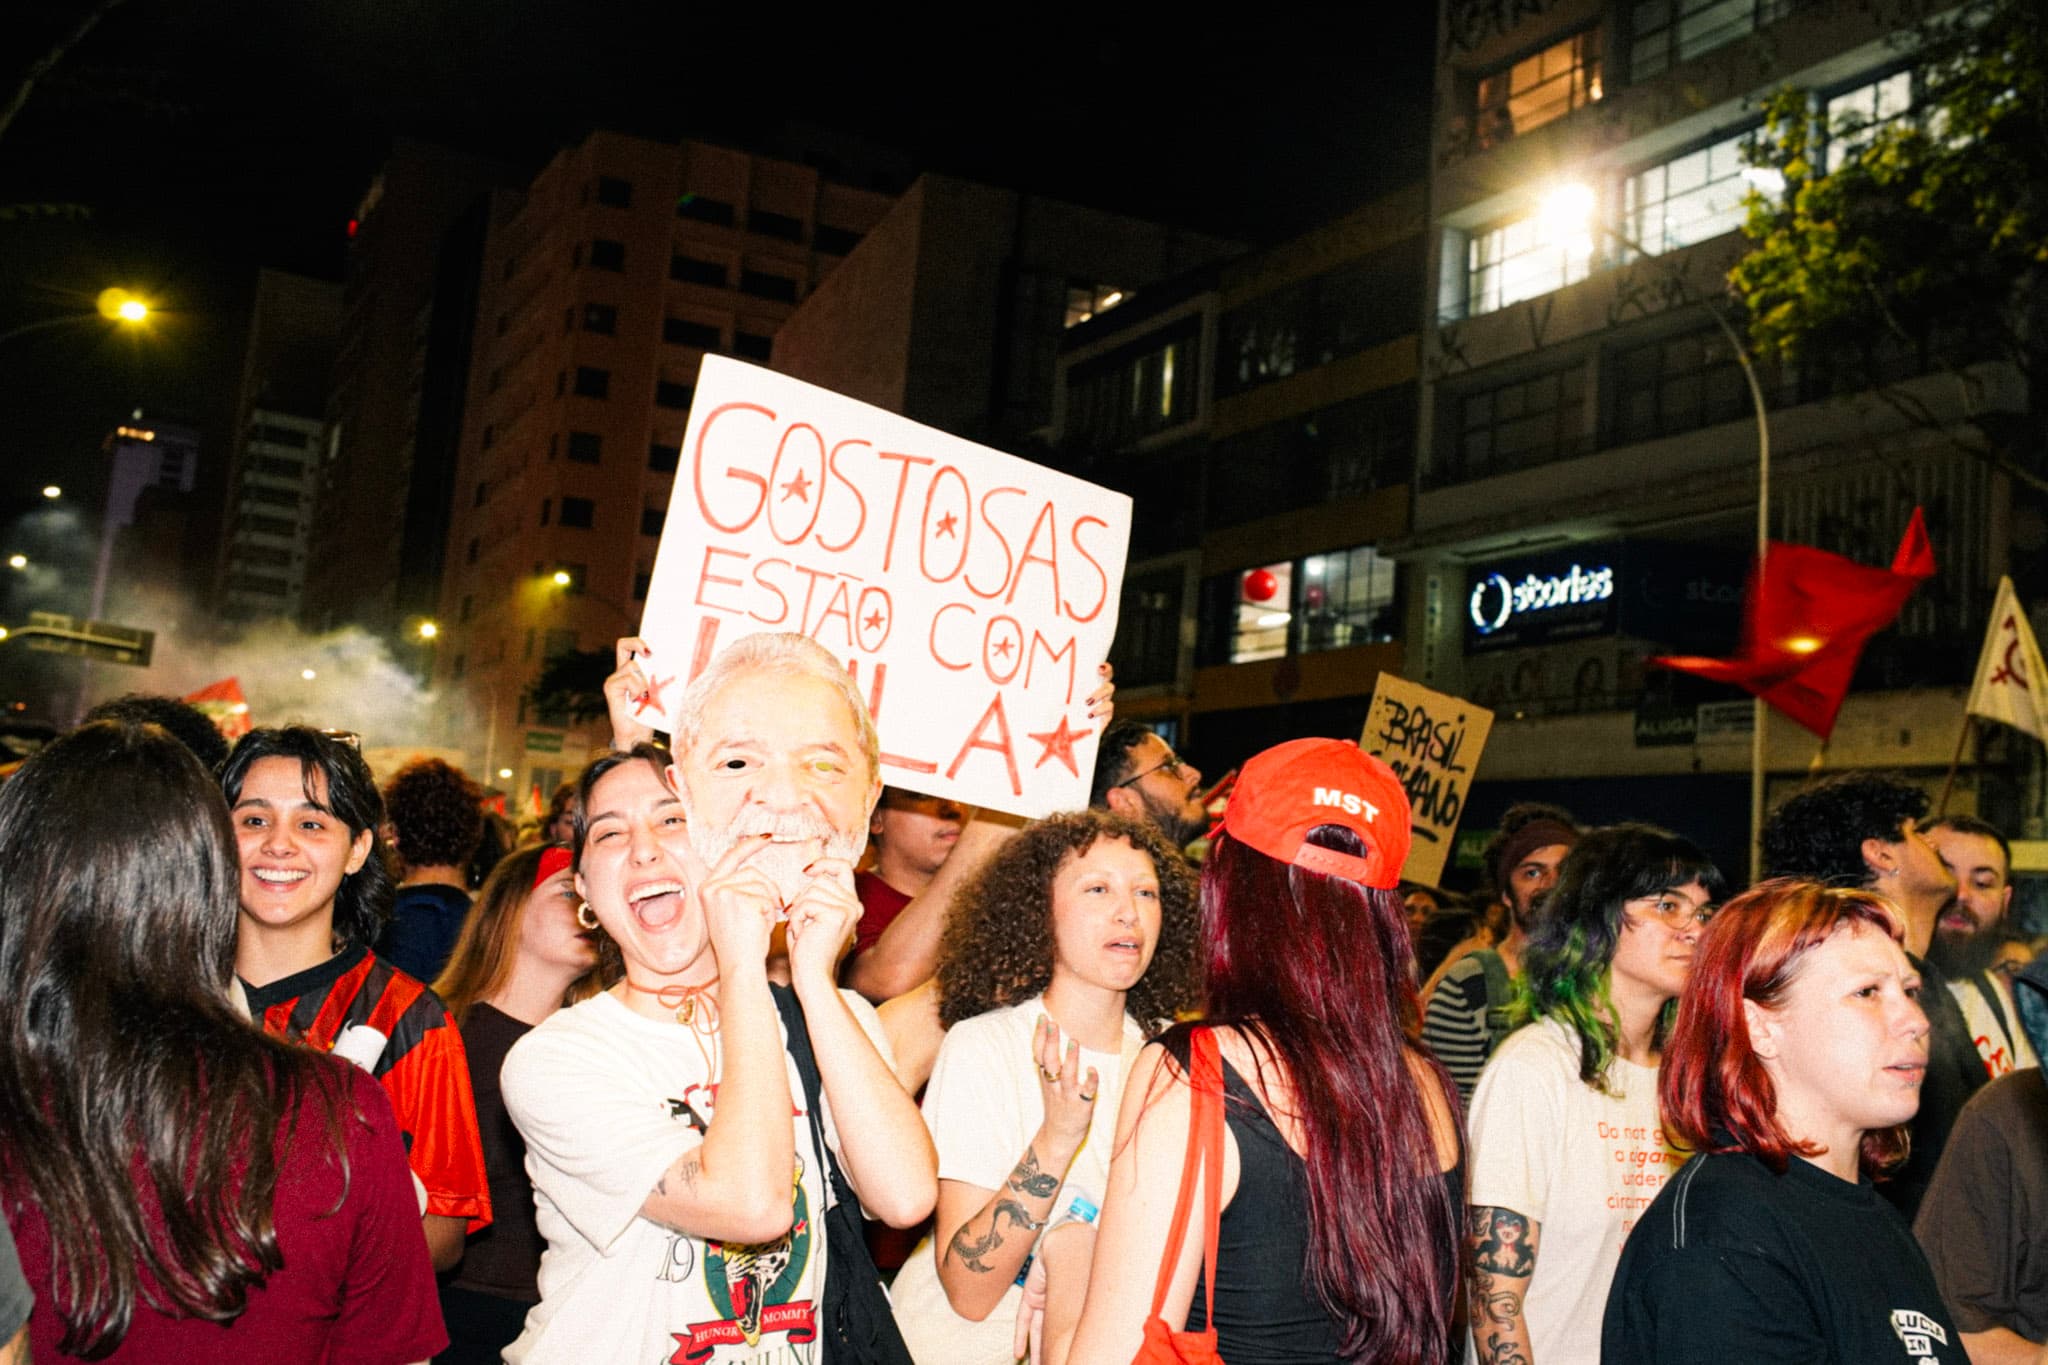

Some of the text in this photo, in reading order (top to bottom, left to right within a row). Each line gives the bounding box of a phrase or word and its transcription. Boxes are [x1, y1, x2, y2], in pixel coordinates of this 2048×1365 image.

[693, 401, 1110, 624] GOSTOSAS
[694, 545, 1077, 705] ESTÃO COM
[1312, 787, 1379, 823] MST
[1597, 1121, 1619, 1139] Do
[1623, 1127, 1647, 1141] not
[655, 1235, 695, 1283] 19
[763, 1308, 810, 1324] MOMMY
